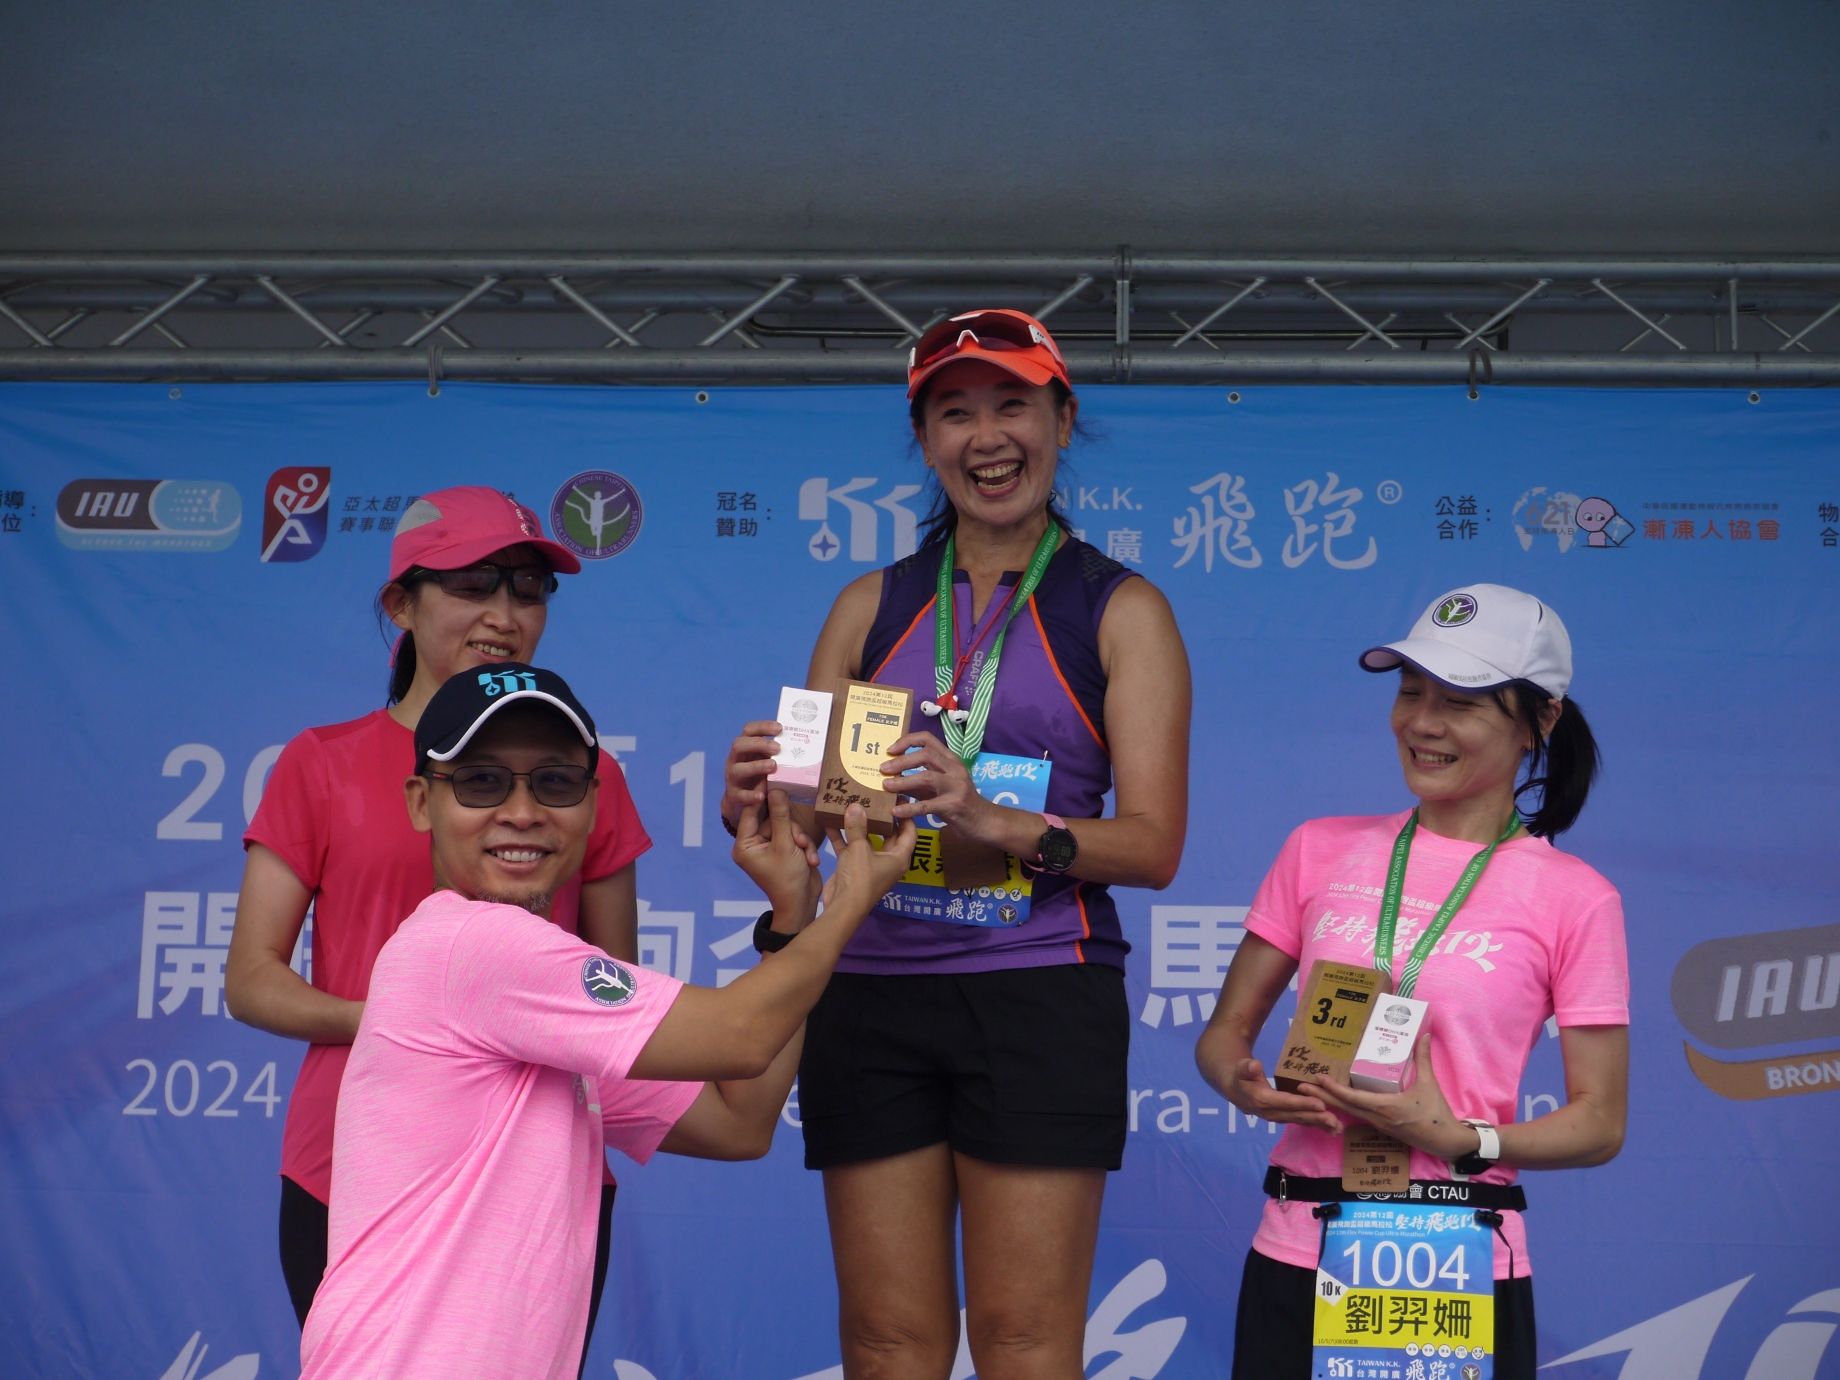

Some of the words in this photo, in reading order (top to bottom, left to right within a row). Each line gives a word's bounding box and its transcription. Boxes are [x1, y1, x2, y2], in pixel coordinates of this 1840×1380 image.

[0, 490, 25, 510] 導
[75, 492, 140, 517] IAU
[1525, 501, 1569, 525] 621
[554, 511, 583, 553] ASSOCIATION
[968, 650, 984, 687] CRAFT
[1415, 932, 1435, 958] CHINESE
[1431, 910, 1449, 932] TAIPEI
[1446, 871, 1474, 911] ASSOCIATION
[1715, 952, 1840, 1023] IAU
[123, 1058, 282, 1118] 2024
[1427, 1185, 1469, 1200] CTAU
[1353, 1211, 1394, 1220] 2024第12屆
[1343, 1239, 1470, 1290] 1004
